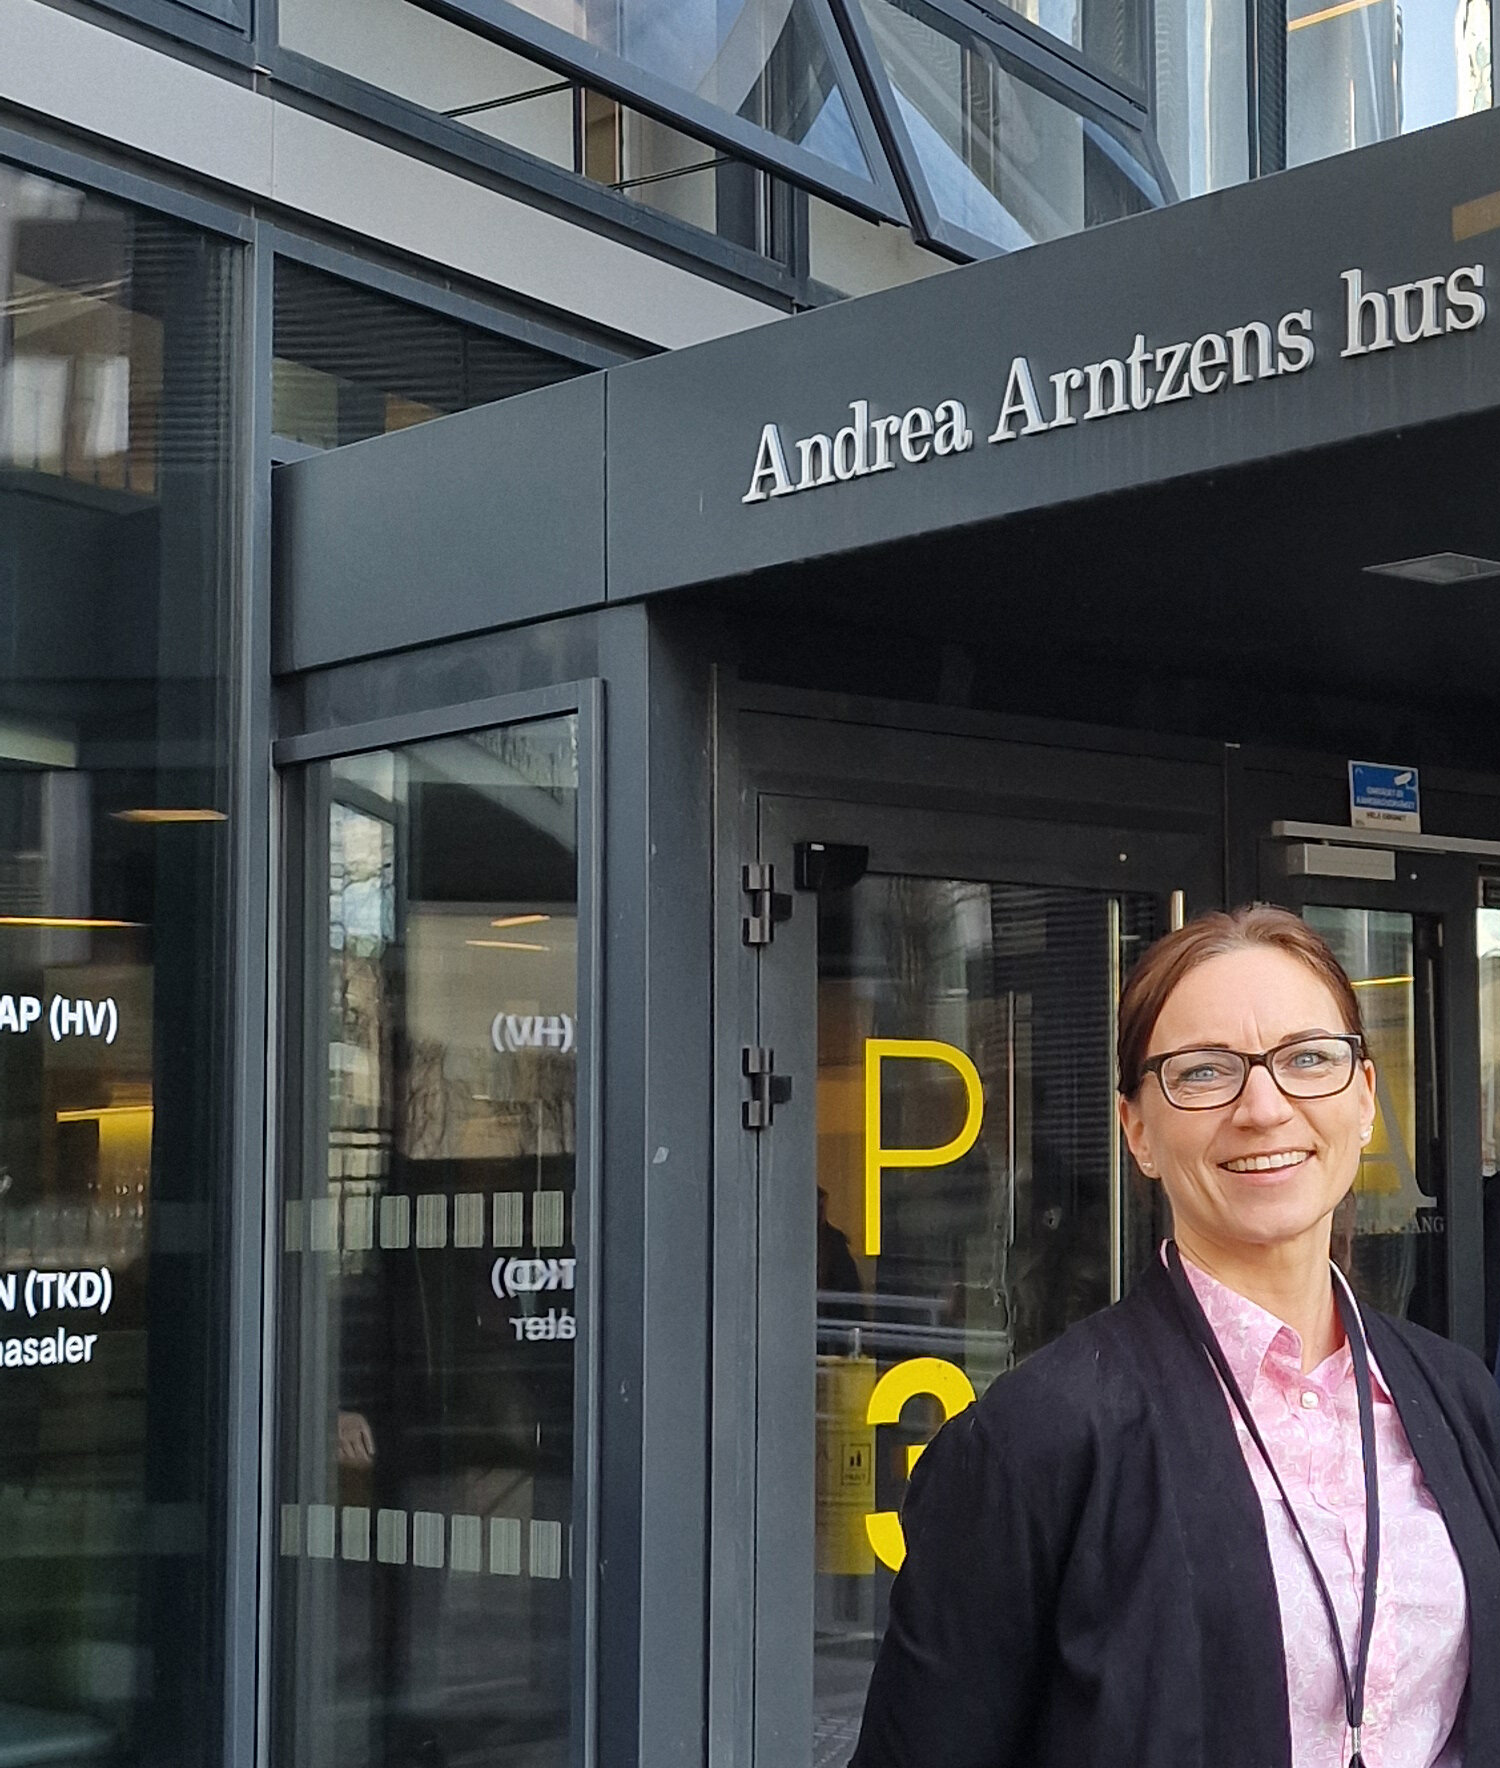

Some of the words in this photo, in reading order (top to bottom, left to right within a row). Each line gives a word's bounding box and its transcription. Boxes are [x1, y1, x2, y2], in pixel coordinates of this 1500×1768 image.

[741, 399, 974, 504] Andrea
[987, 308, 1315, 444] Arntzens
[1339, 264, 1487, 357] hus
[49, 993, 118, 1045] (HV)
[864, 1037, 985, 1257] P
[24, 1267, 112, 1318] (TKD)
[0, 1326, 98, 1368] asaler
